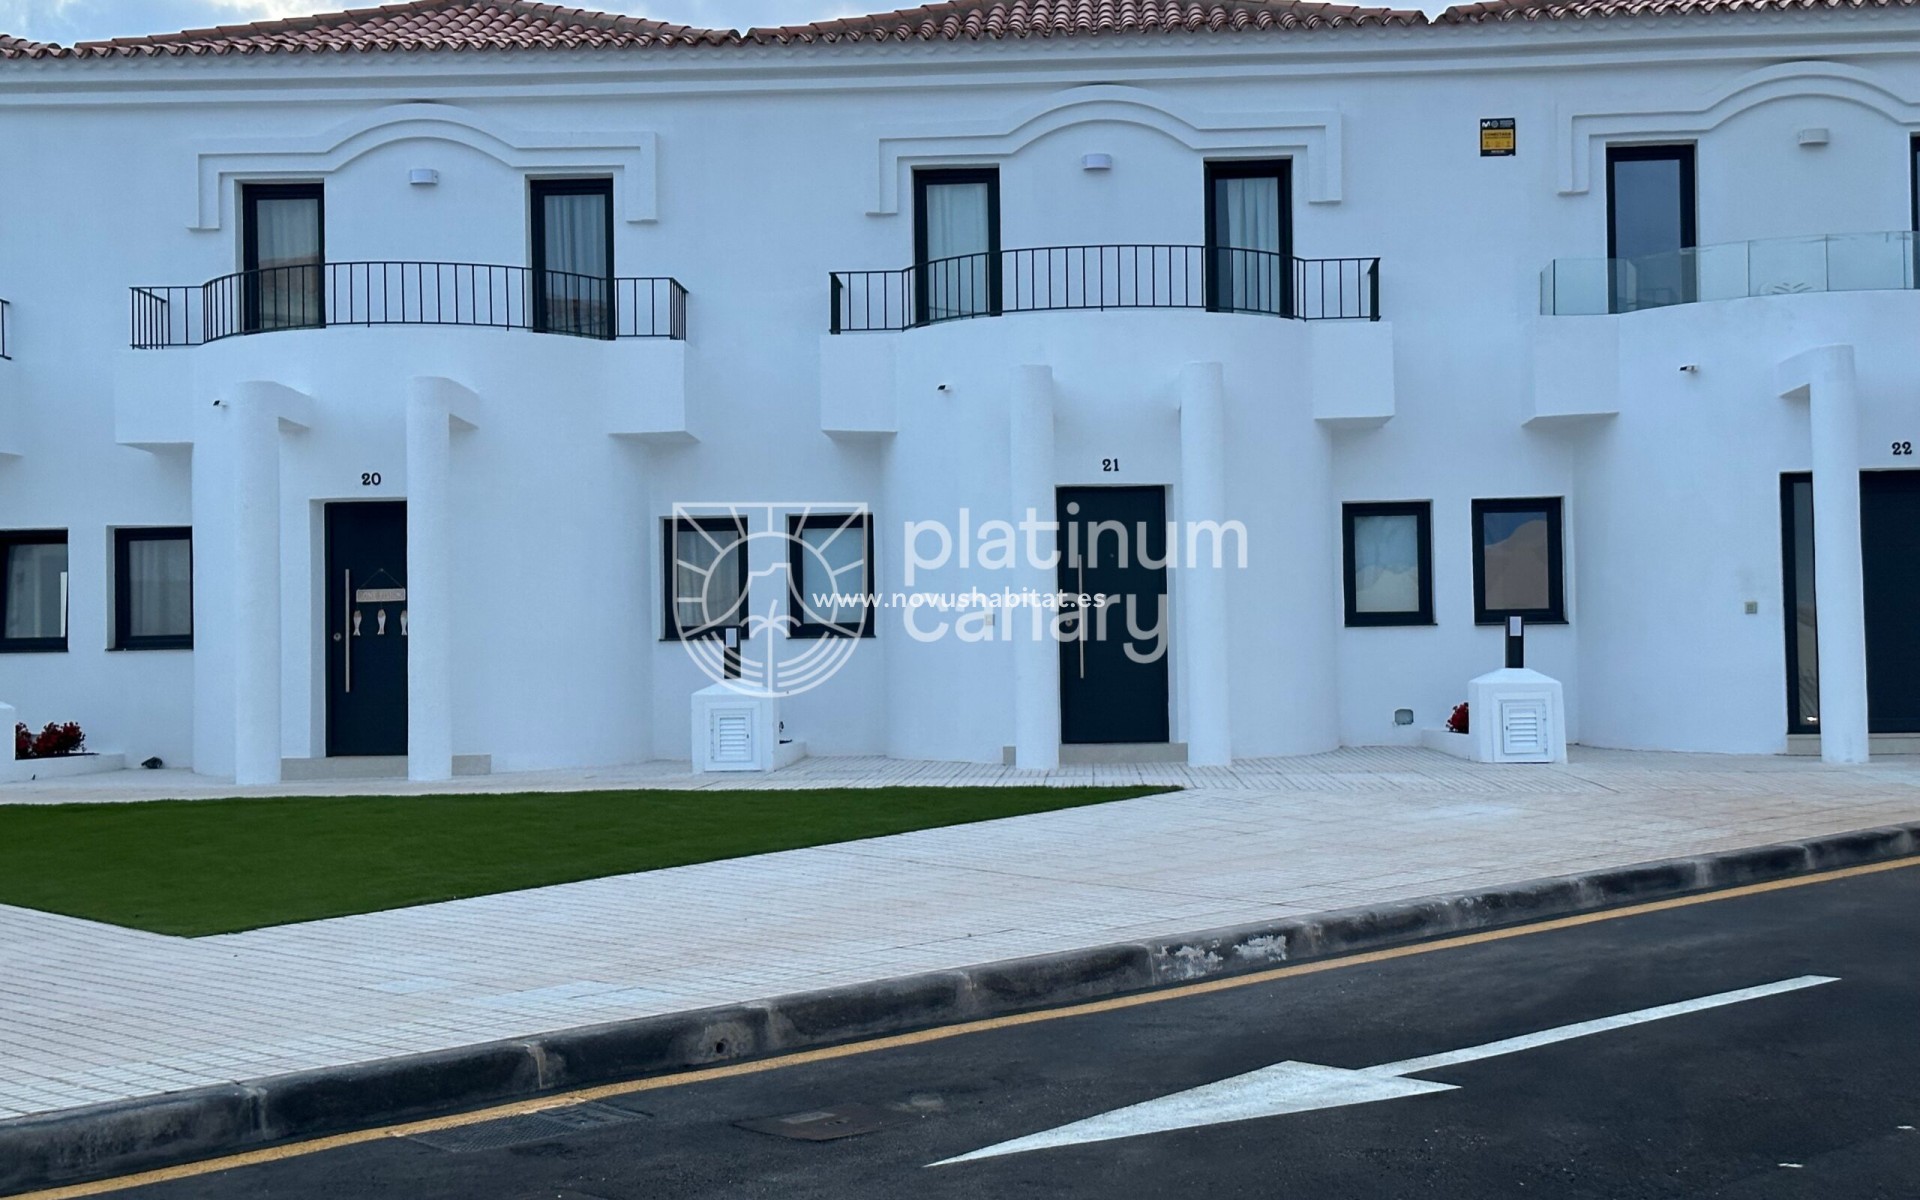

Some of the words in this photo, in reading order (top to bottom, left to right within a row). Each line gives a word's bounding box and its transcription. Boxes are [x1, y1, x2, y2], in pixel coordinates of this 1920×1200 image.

[1892, 441, 1912, 456] 22
[1102, 458, 1119, 472] 21
[361, 472, 381, 486] 20
